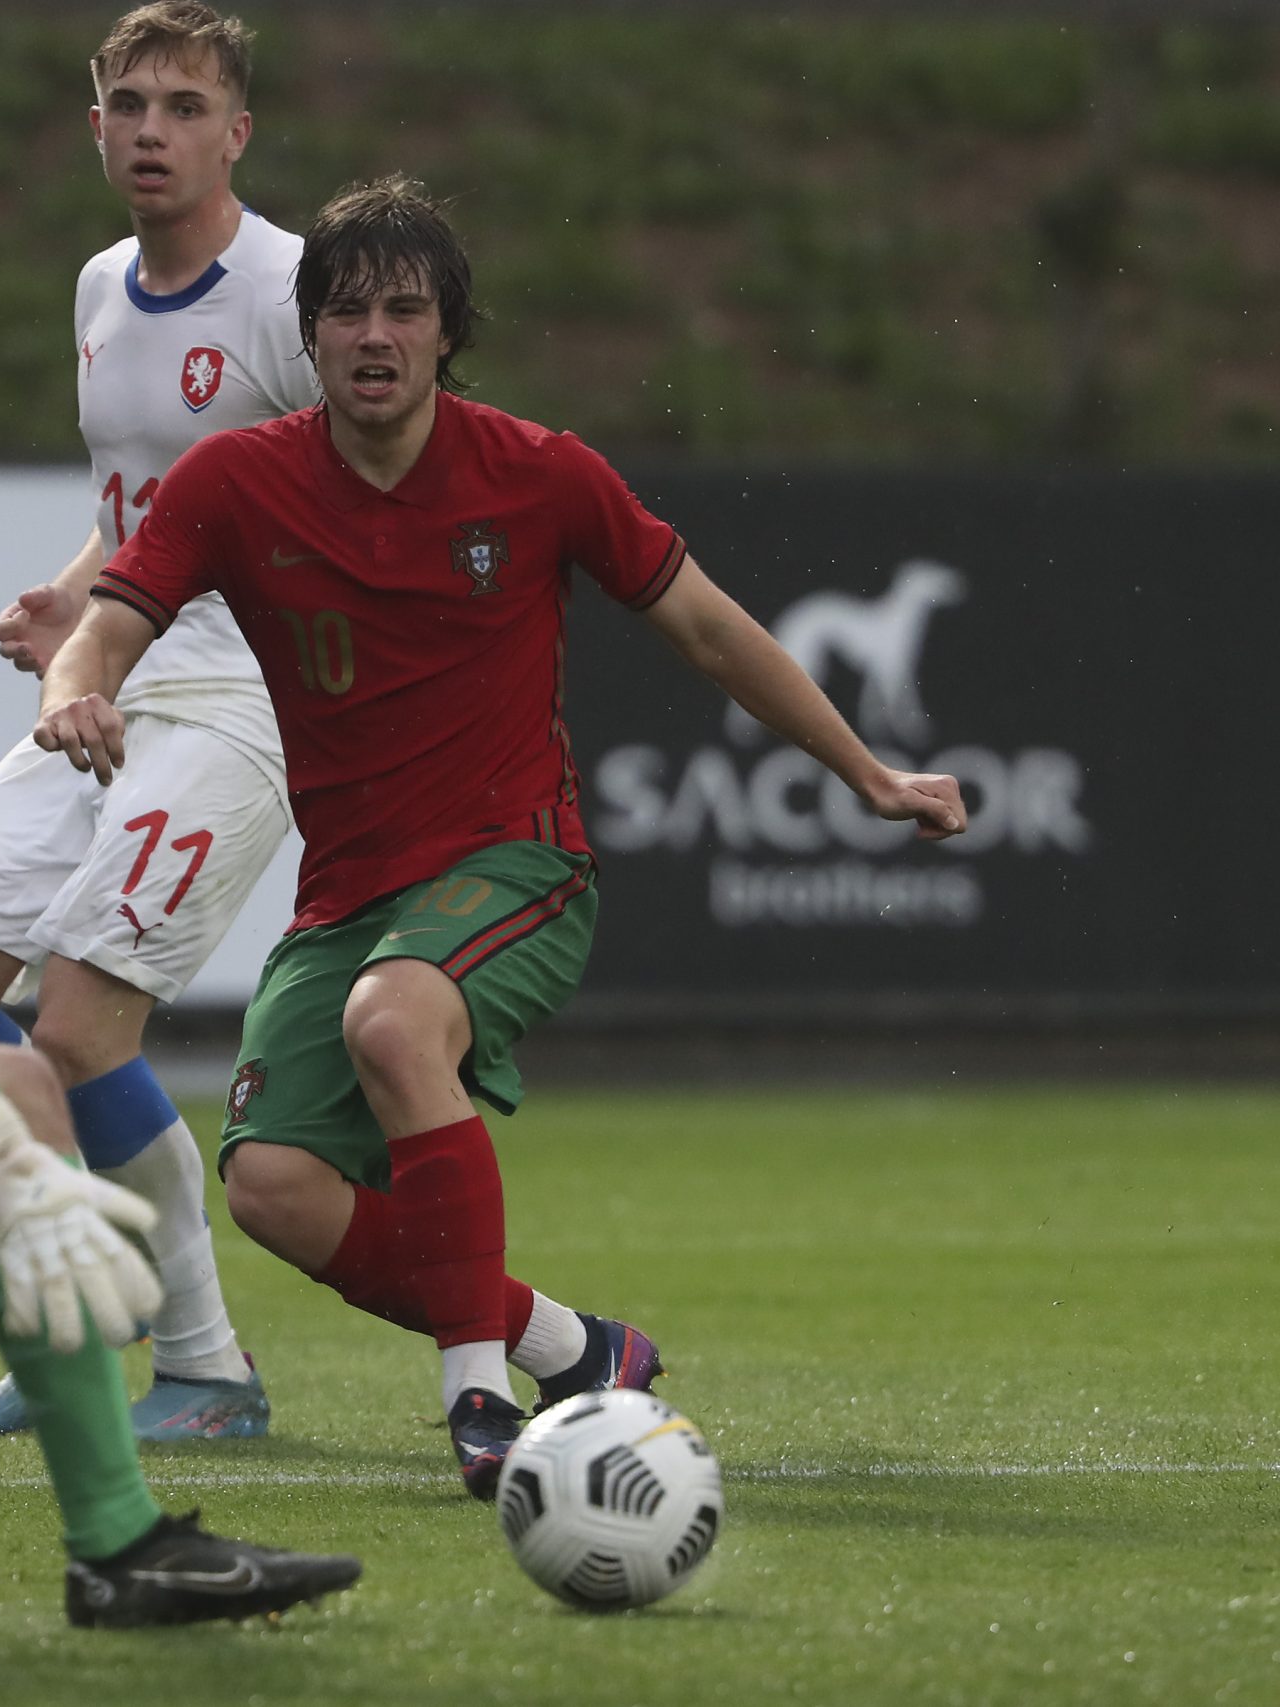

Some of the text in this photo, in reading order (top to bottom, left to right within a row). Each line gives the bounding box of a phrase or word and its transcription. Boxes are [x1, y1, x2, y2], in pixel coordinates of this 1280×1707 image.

[277, 609, 354, 695] 10
[121, 808, 213, 916] 11
[414, 876, 493, 916] 10
